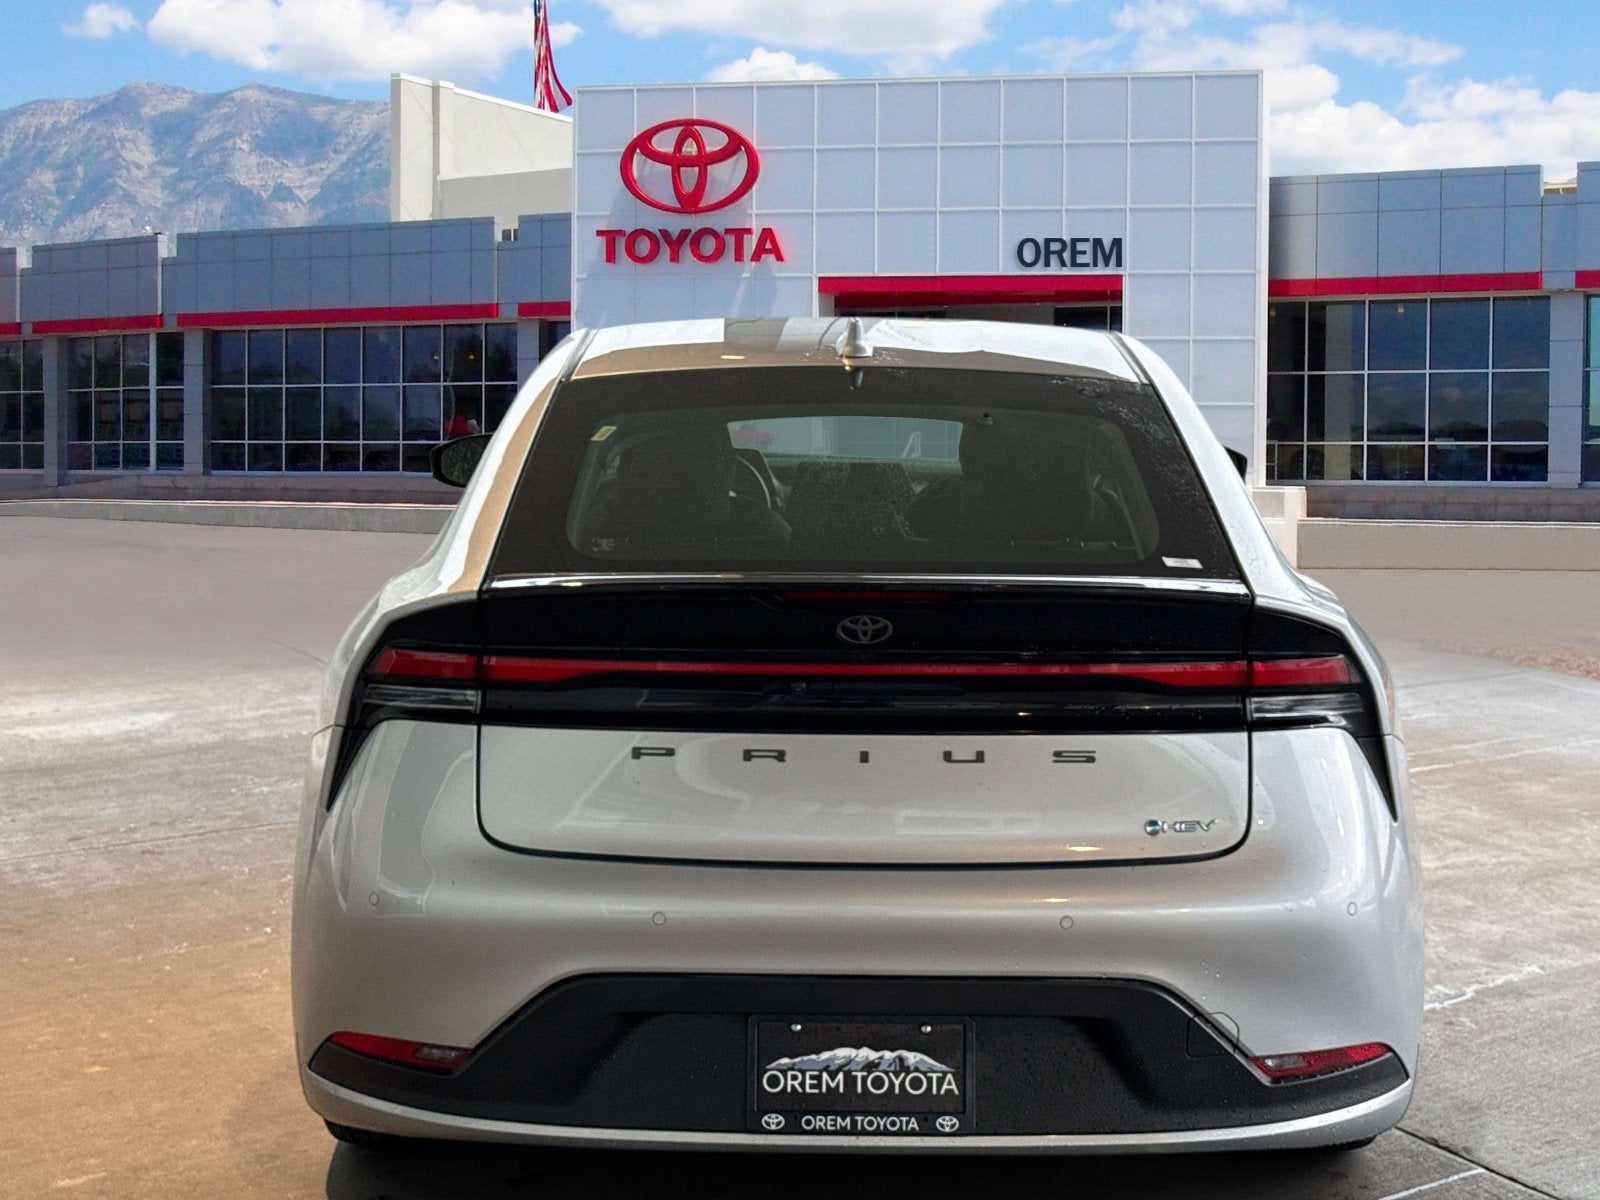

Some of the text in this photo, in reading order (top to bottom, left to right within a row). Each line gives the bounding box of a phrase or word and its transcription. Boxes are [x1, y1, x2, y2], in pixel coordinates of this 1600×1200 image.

[596, 227, 786, 264] TOYOTA
[1016, 237, 1123, 268] OREM
[631, 746, 1097, 764] PRIUS
[762, 1070, 960, 1096] OREM TOYOTA
[801, 1115, 920, 1132] OREM TOYOTA
